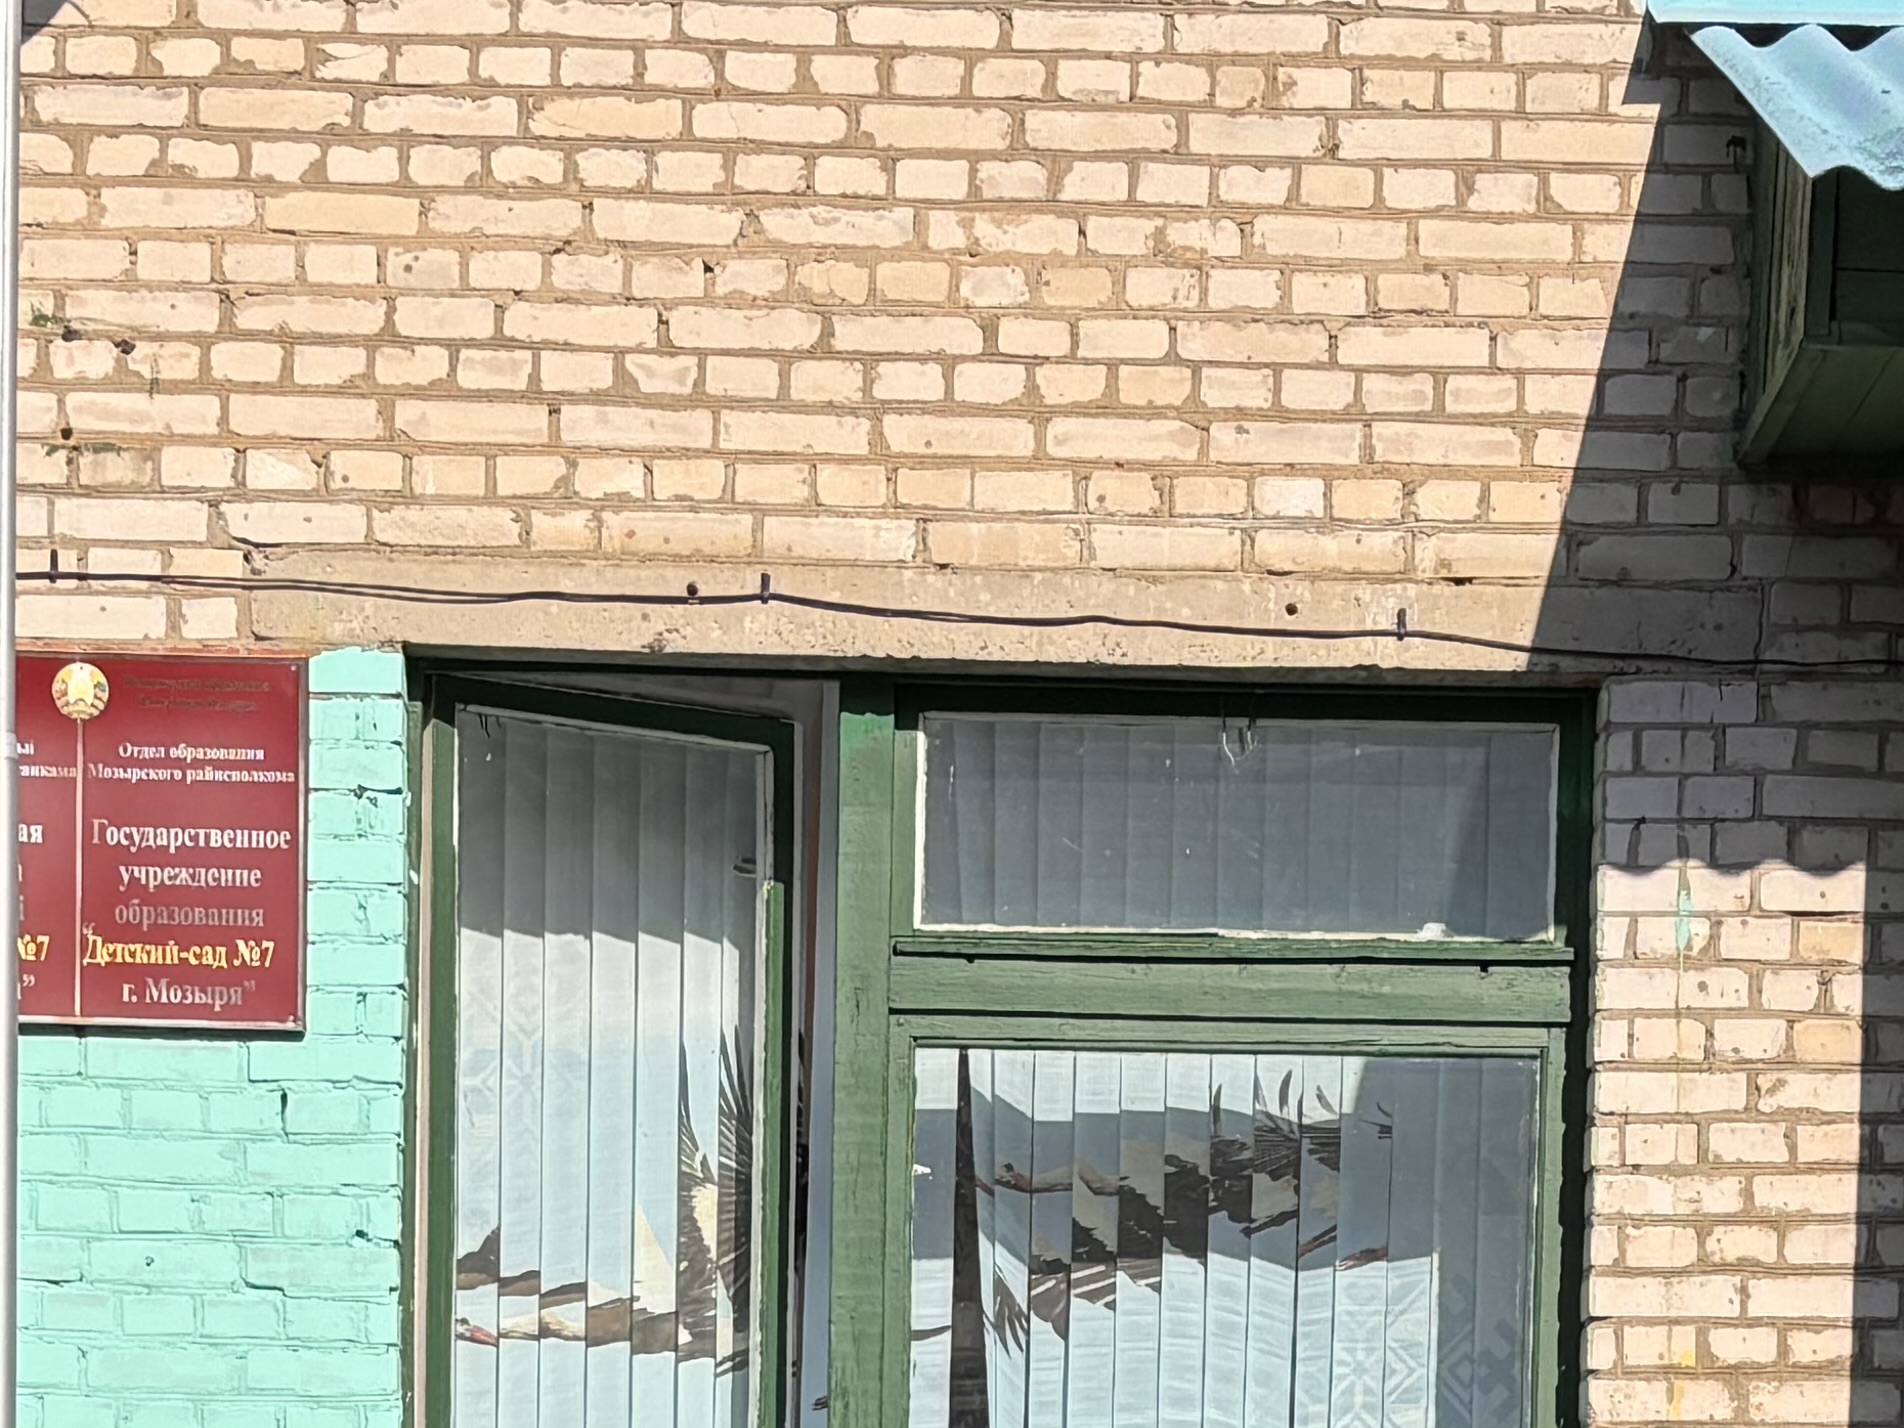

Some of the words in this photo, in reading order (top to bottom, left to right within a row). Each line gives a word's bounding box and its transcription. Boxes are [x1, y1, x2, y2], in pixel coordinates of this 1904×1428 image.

[118, 742, 165, 759] Отдел
[170, 743, 265, 763] образования
[88, 763, 182, 783] Мозырского
[186, 766, 295, 784] райисполкома
[92, 819, 291, 854] Государственное
[119, 865, 261, 892] учреждение
[115, 899, 264, 931] образования
[232, 939, 275, 967] №7
[122, 983, 138, 1003] г.
